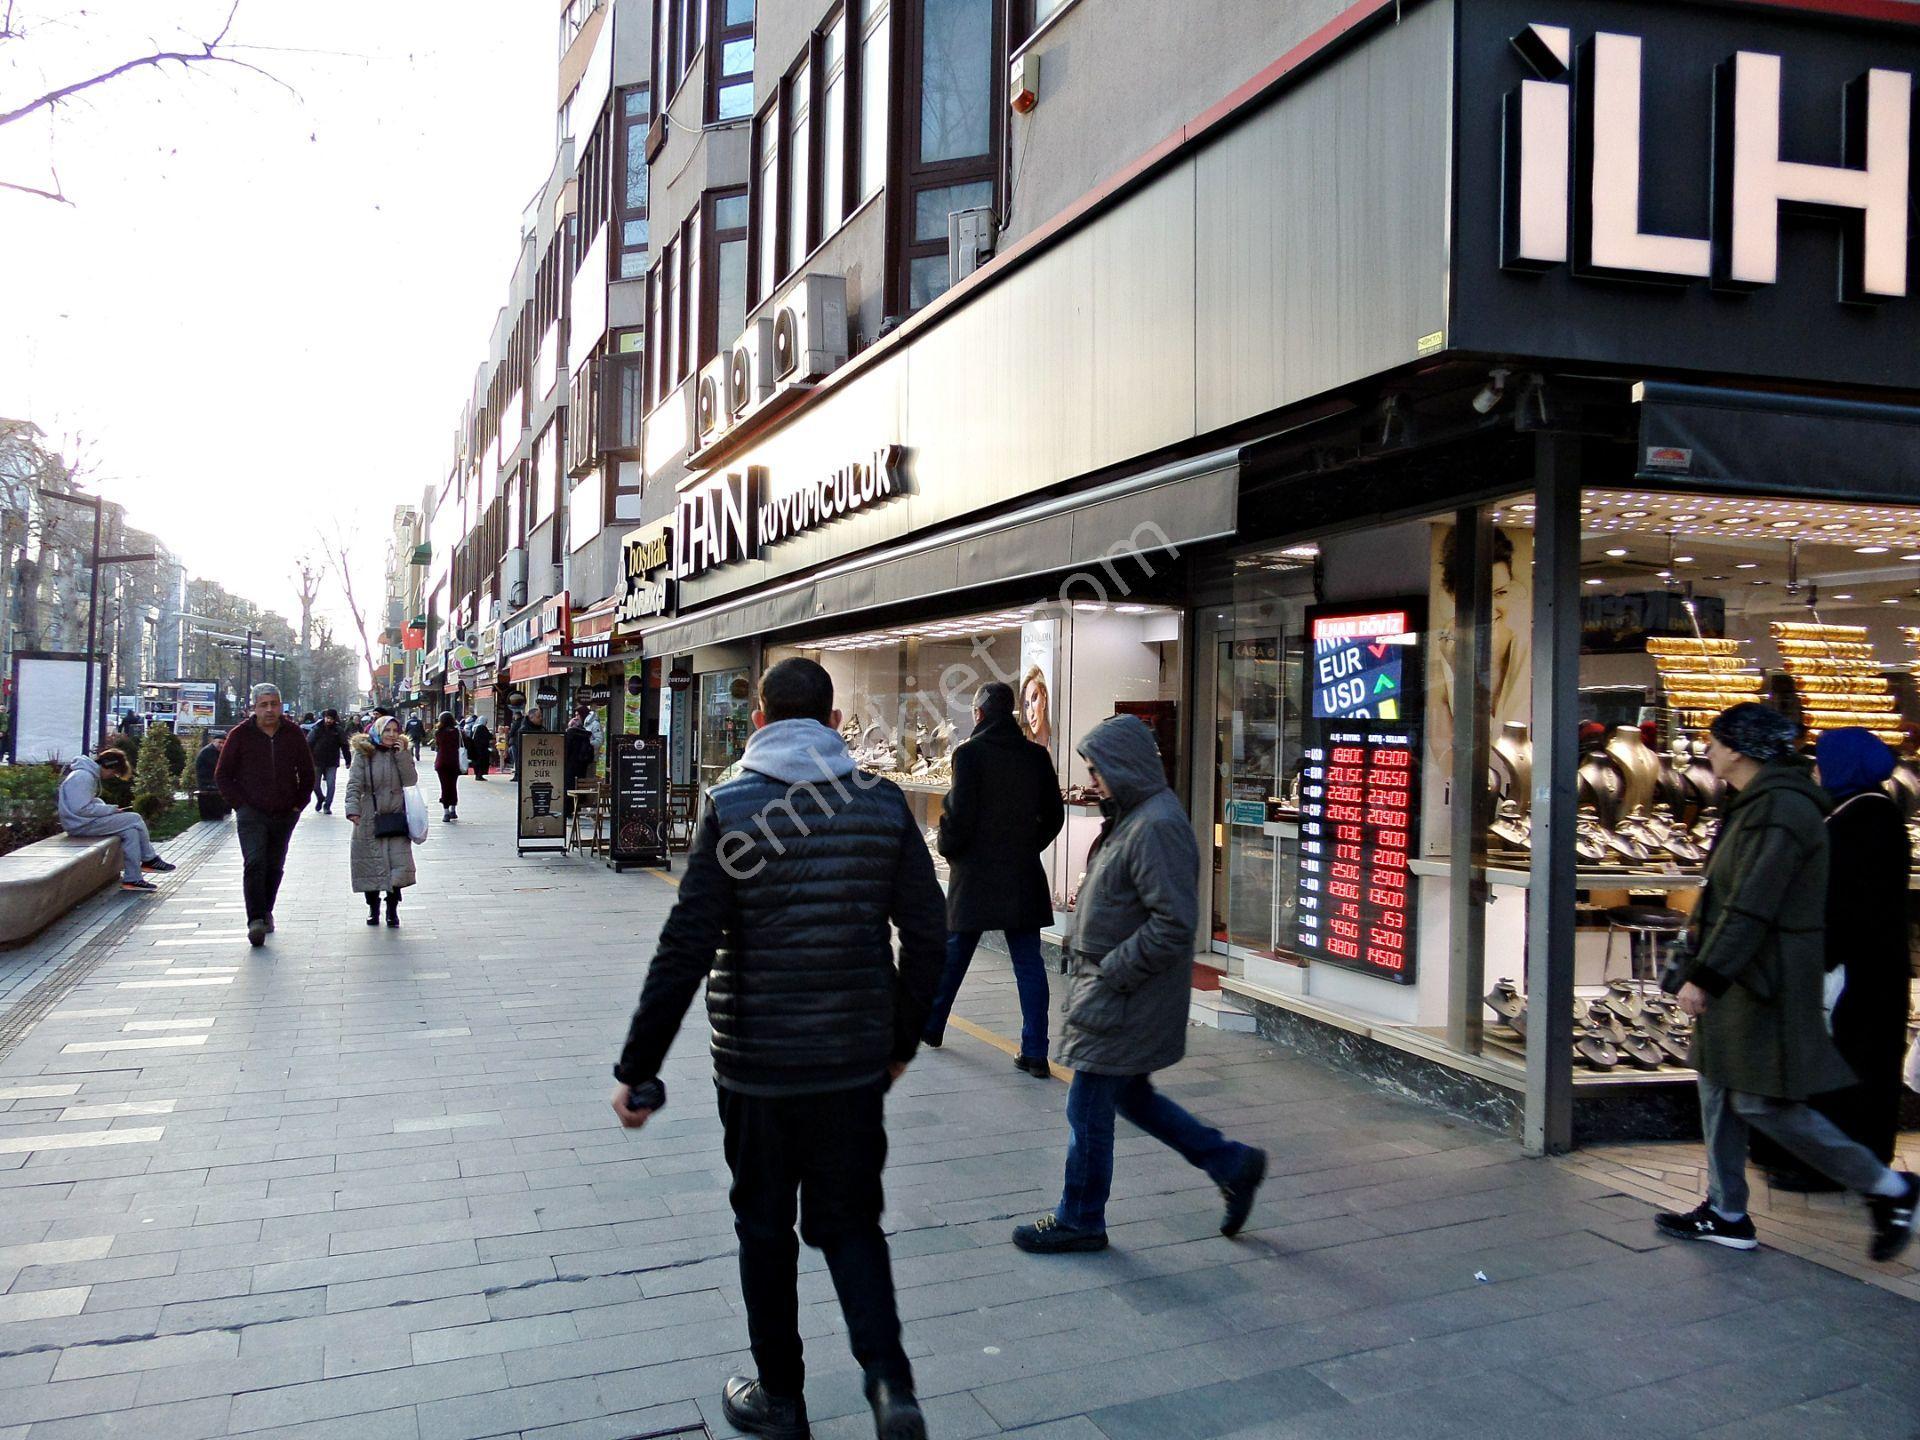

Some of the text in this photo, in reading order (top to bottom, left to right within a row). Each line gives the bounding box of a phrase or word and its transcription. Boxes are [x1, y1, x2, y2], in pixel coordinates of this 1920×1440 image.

[758, 448, 891, 547] KUYUMCULUK
[1319, 647, 1363, 684] EUR
[592, 691, 611, 699] LATTE
[1323, 677, 1366, 713] USD
